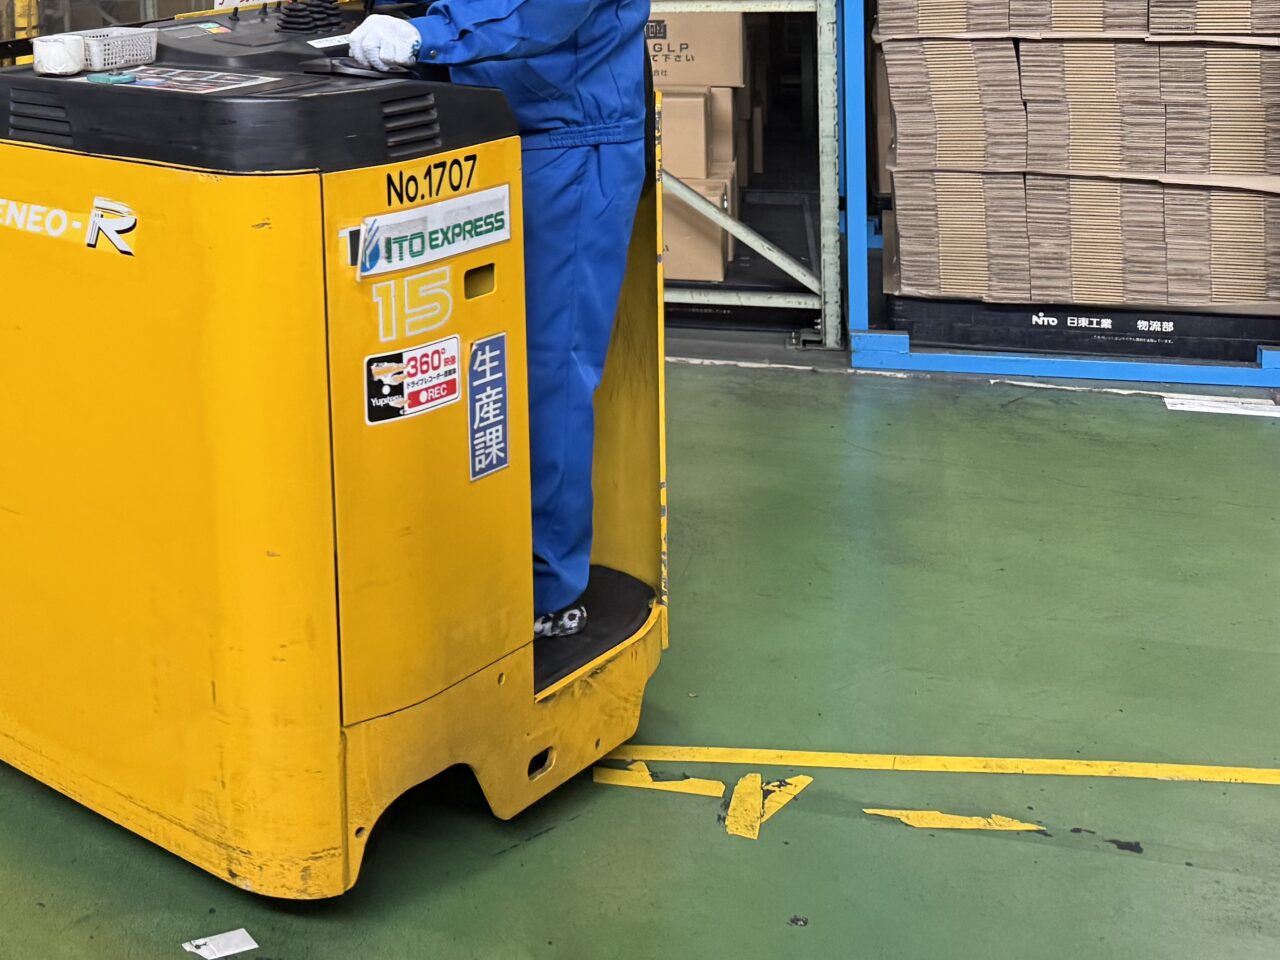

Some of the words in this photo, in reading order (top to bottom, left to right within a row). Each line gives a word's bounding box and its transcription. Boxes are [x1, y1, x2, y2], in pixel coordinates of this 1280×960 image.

[387, 154, 477, 206] No.1707
[384, 232, 425, 265] ITO
[429, 210, 505, 250] EXPRESS
[372, 266, 453, 343] 15
[1067, 317, 1112, 329] 日東工業
[1137, 320, 1174, 332] 物流部
[428, 384, 447, 400] REC
[472, 345, 505, 471] 生産課
